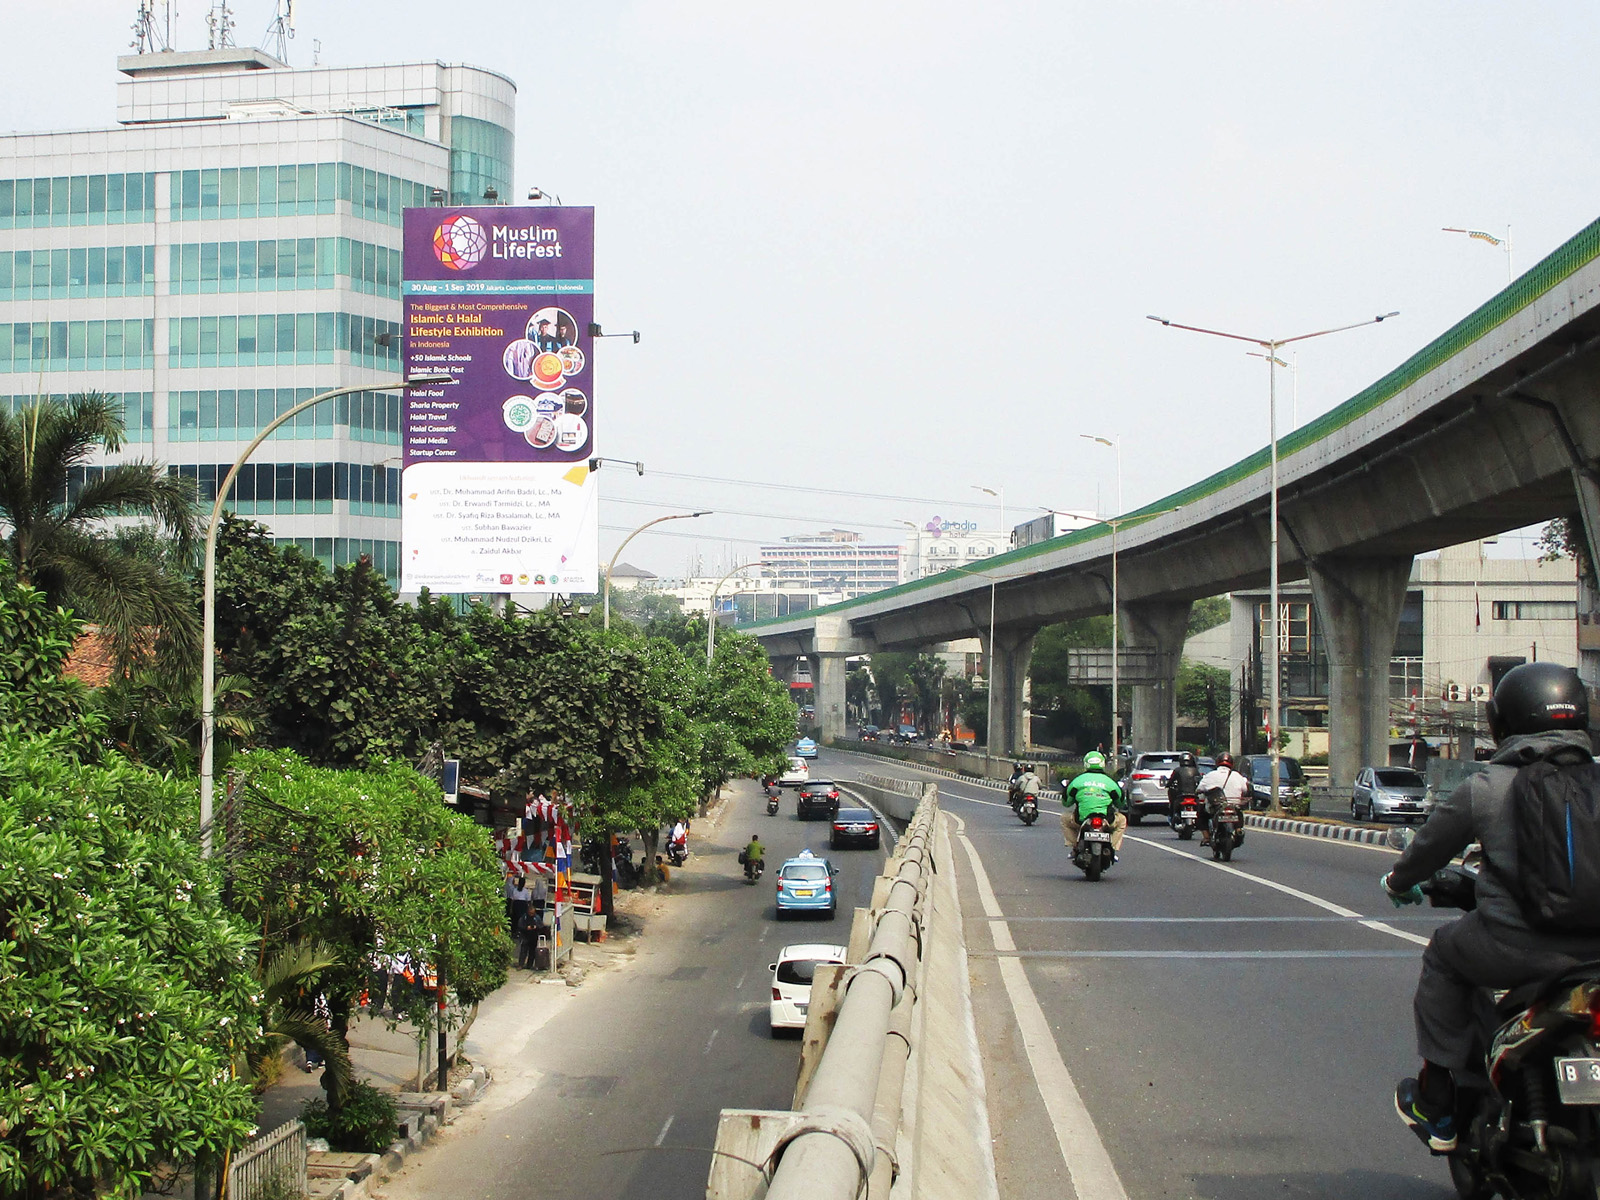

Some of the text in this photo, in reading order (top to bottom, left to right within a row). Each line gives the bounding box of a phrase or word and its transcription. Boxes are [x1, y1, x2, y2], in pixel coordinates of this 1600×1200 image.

[492, 225, 557, 243] Muslim
[492, 242, 562, 260] LifeFest
[411, 283, 421, 292] 30
[421, 283, 437, 293] Aug
[444, 283, 449, 292] 1
[451, 283, 465, 293] Sep
[466, 283, 485, 292] 2019
[410, 303, 528, 312] The Biggest & Most Comprehensive
[410, 314, 482, 324] Islamic & Halal
[410, 327, 504, 338] Lifestyle Exhibition
[417, 341, 450, 349] Indonesia
[410, 354, 472, 362] +50 Islamic Schools
[410, 366, 465, 374] Islamic Book Fest
[431, 402, 460, 410] Property
[409, 413, 448, 421] Halal Travel
[409, 425, 457, 433] Halal Cosmetic
[409, 437, 448, 445] Halal Media
[409, 449, 434, 457] Startup
[455, 488, 496, 496] Muhammad
[496, 488, 516, 496] Arifin
[464, 500, 493, 508] Erwandi
[494, 500, 525, 509] Tarmidzi,
[538, 500, 551, 508] MA
[458, 512, 479, 521] Syafiq
[480, 512, 495, 520] Riza
[496, 512, 535, 521] Basalamah,
[548, 512, 561, 520] MA
[474, 524, 500, 532] Subhan
[501, 524, 532, 532] Bawazier
[479, 547, 501, 555] Zaidul
[501, 547, 523, 555] Akbar
[1545, 703, 1577, 711] HONDA
[1565, 1064, 1577, 1082] B
